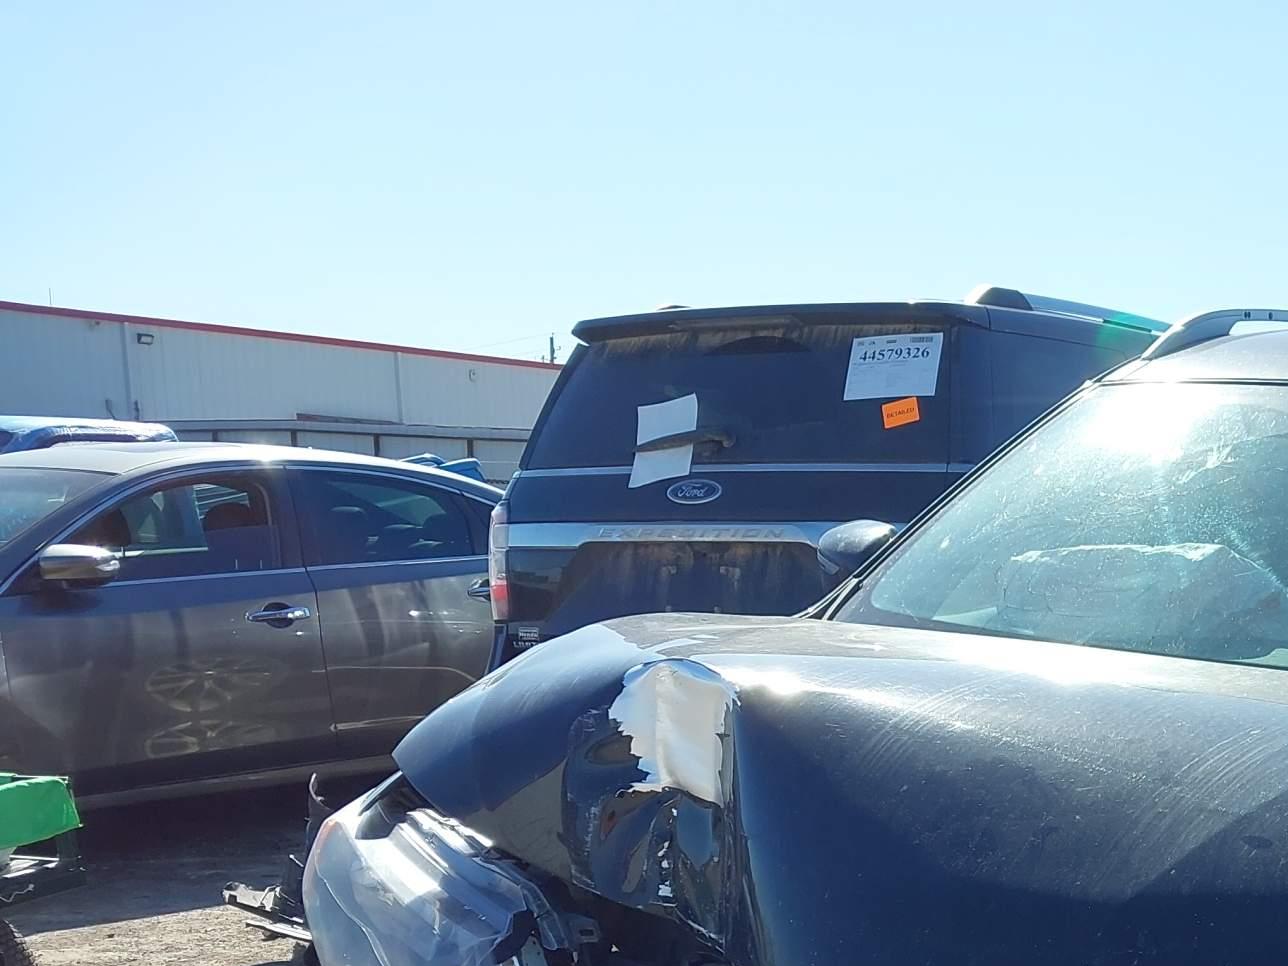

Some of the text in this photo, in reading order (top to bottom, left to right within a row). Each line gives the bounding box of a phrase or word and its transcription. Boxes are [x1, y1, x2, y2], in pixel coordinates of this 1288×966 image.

[859, 347, 930, 362] 44579326
[677, 485, 708, 498] Ford
[597, 527, 786, 539] EXPEDITION
